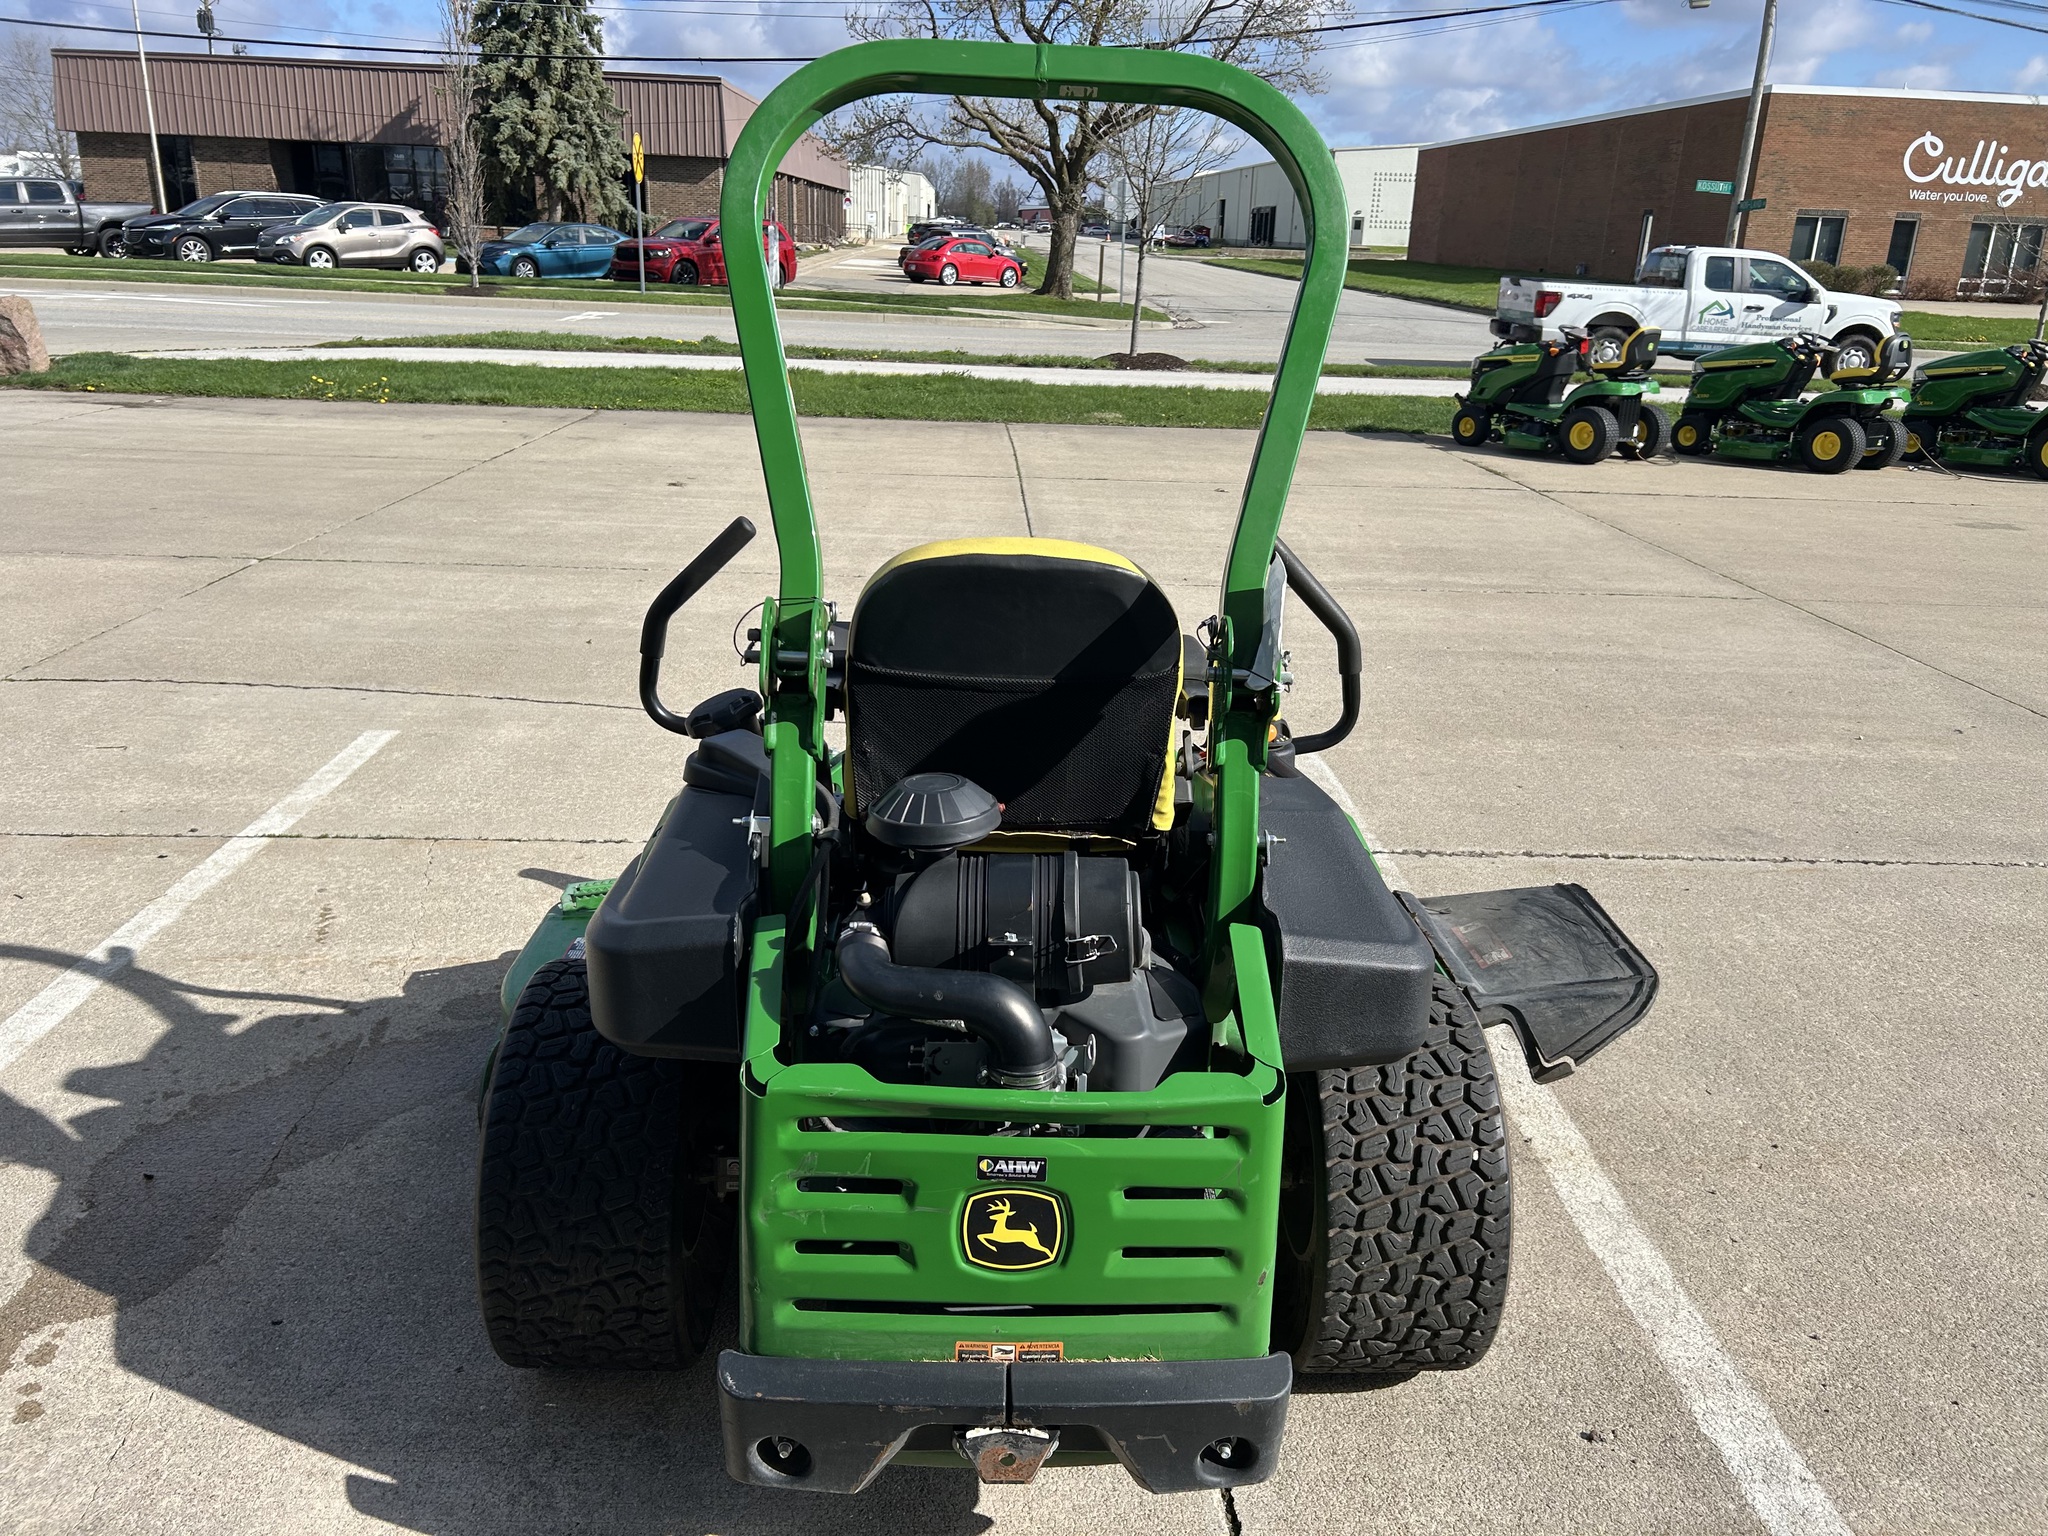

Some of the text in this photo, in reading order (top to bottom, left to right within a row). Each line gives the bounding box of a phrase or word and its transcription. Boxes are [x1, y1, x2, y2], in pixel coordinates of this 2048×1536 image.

[1697, 181, 1728, 192] KOSSUTH
[1909, 189, 1990, 204] Water you love.
[1703, 318, 1729, 326] HOME
[1756, 315, 1802, 323] Professional
[1741, 321, 1812, 332] Handyman Services
[993, 1160, 1041, 1174] AHW
